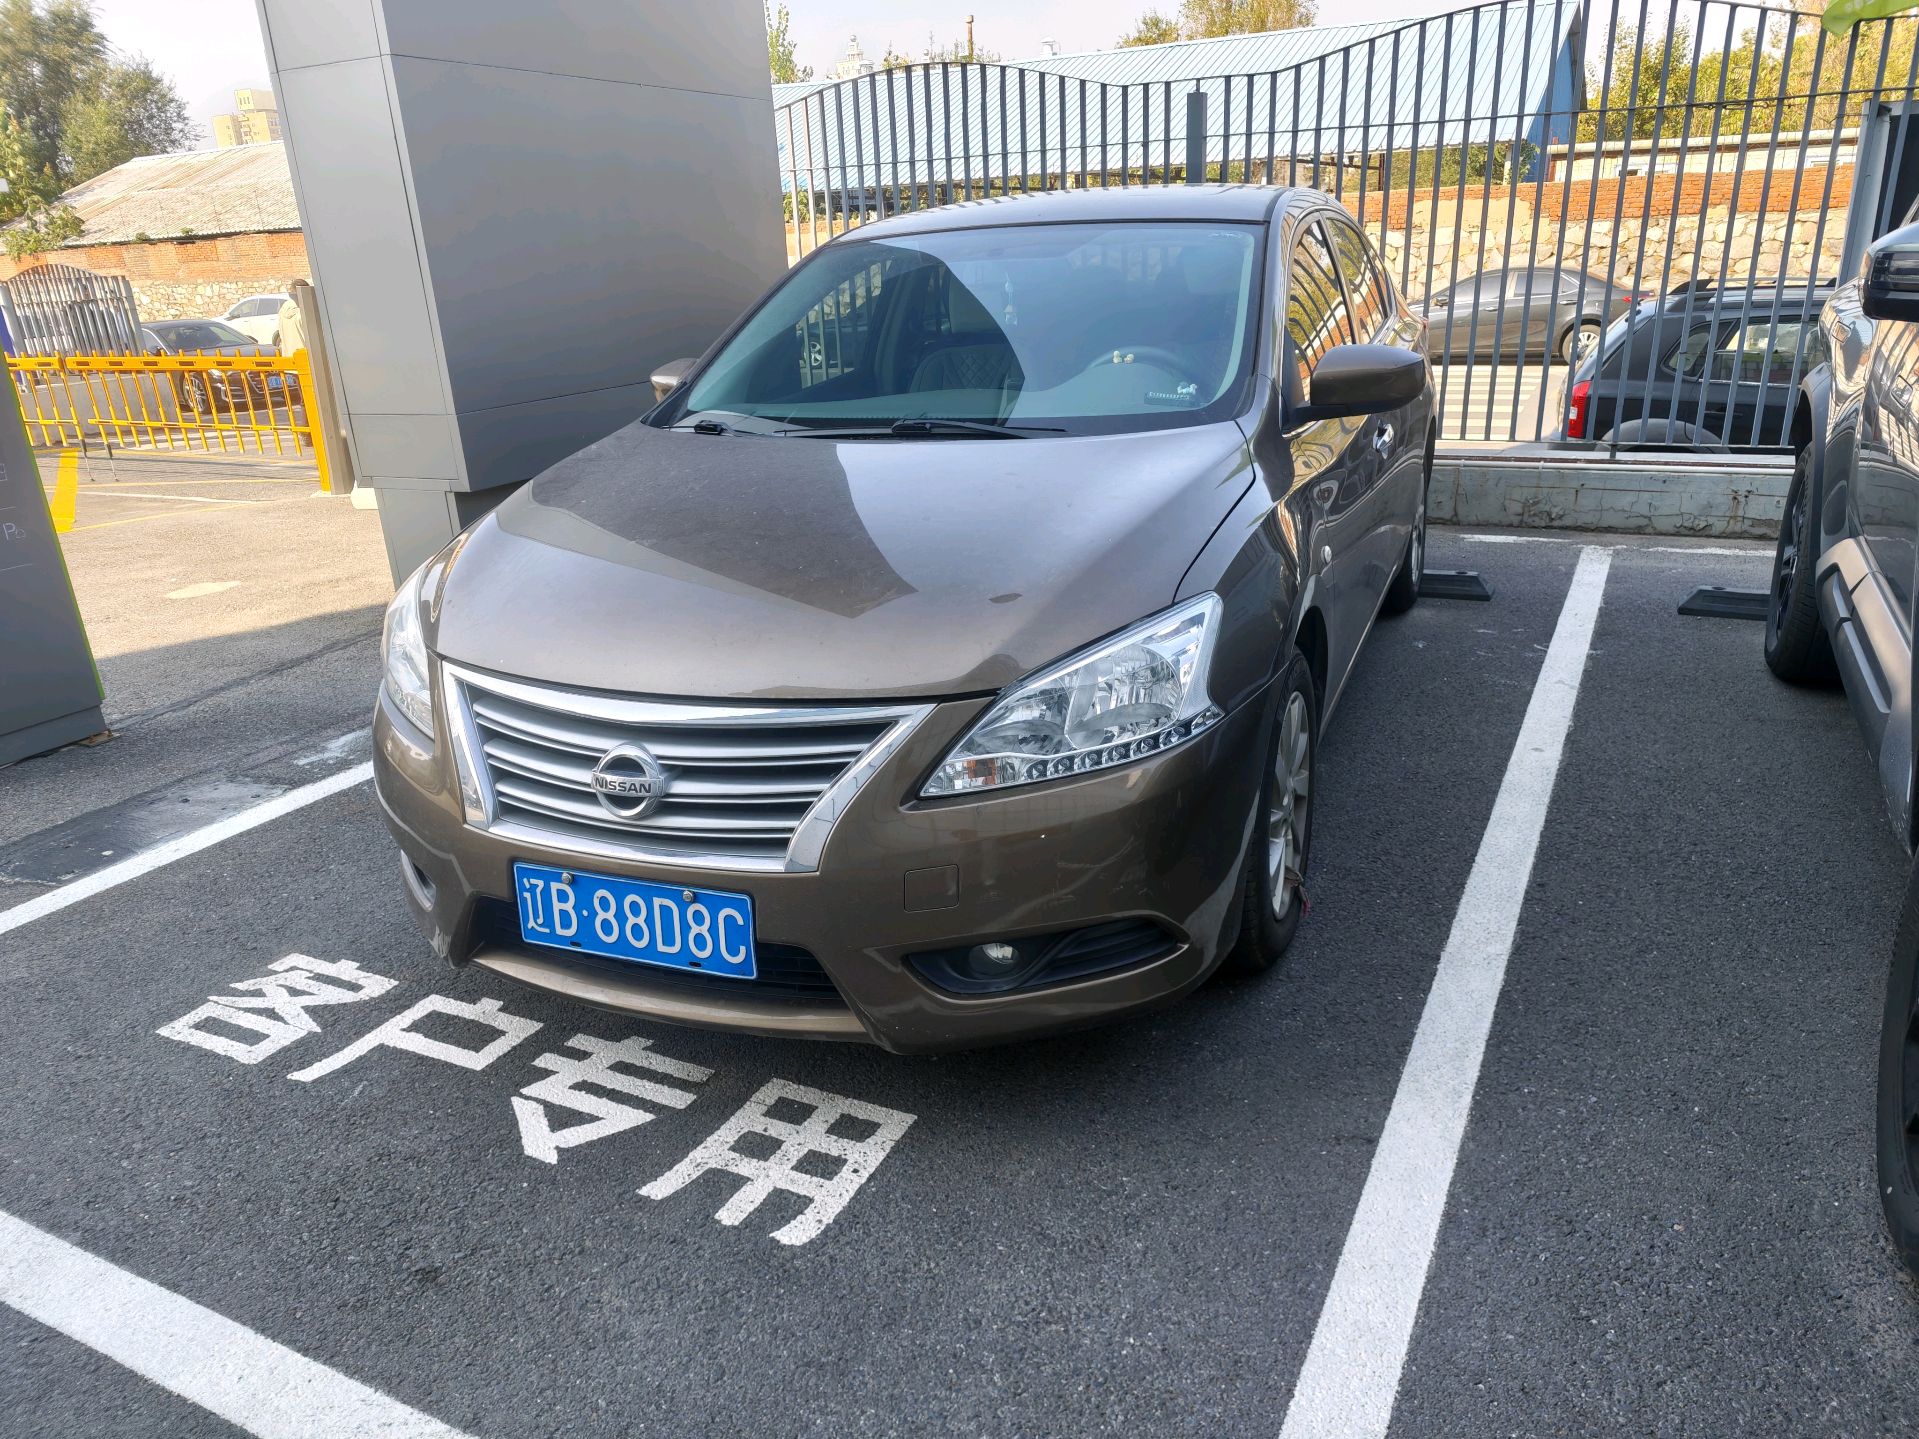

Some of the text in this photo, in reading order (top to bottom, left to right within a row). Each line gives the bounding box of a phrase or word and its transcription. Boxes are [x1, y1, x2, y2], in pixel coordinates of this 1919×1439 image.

[595, 776, 652, 794] NISSAN
[155, 953, 918, 1246] 客户专用
